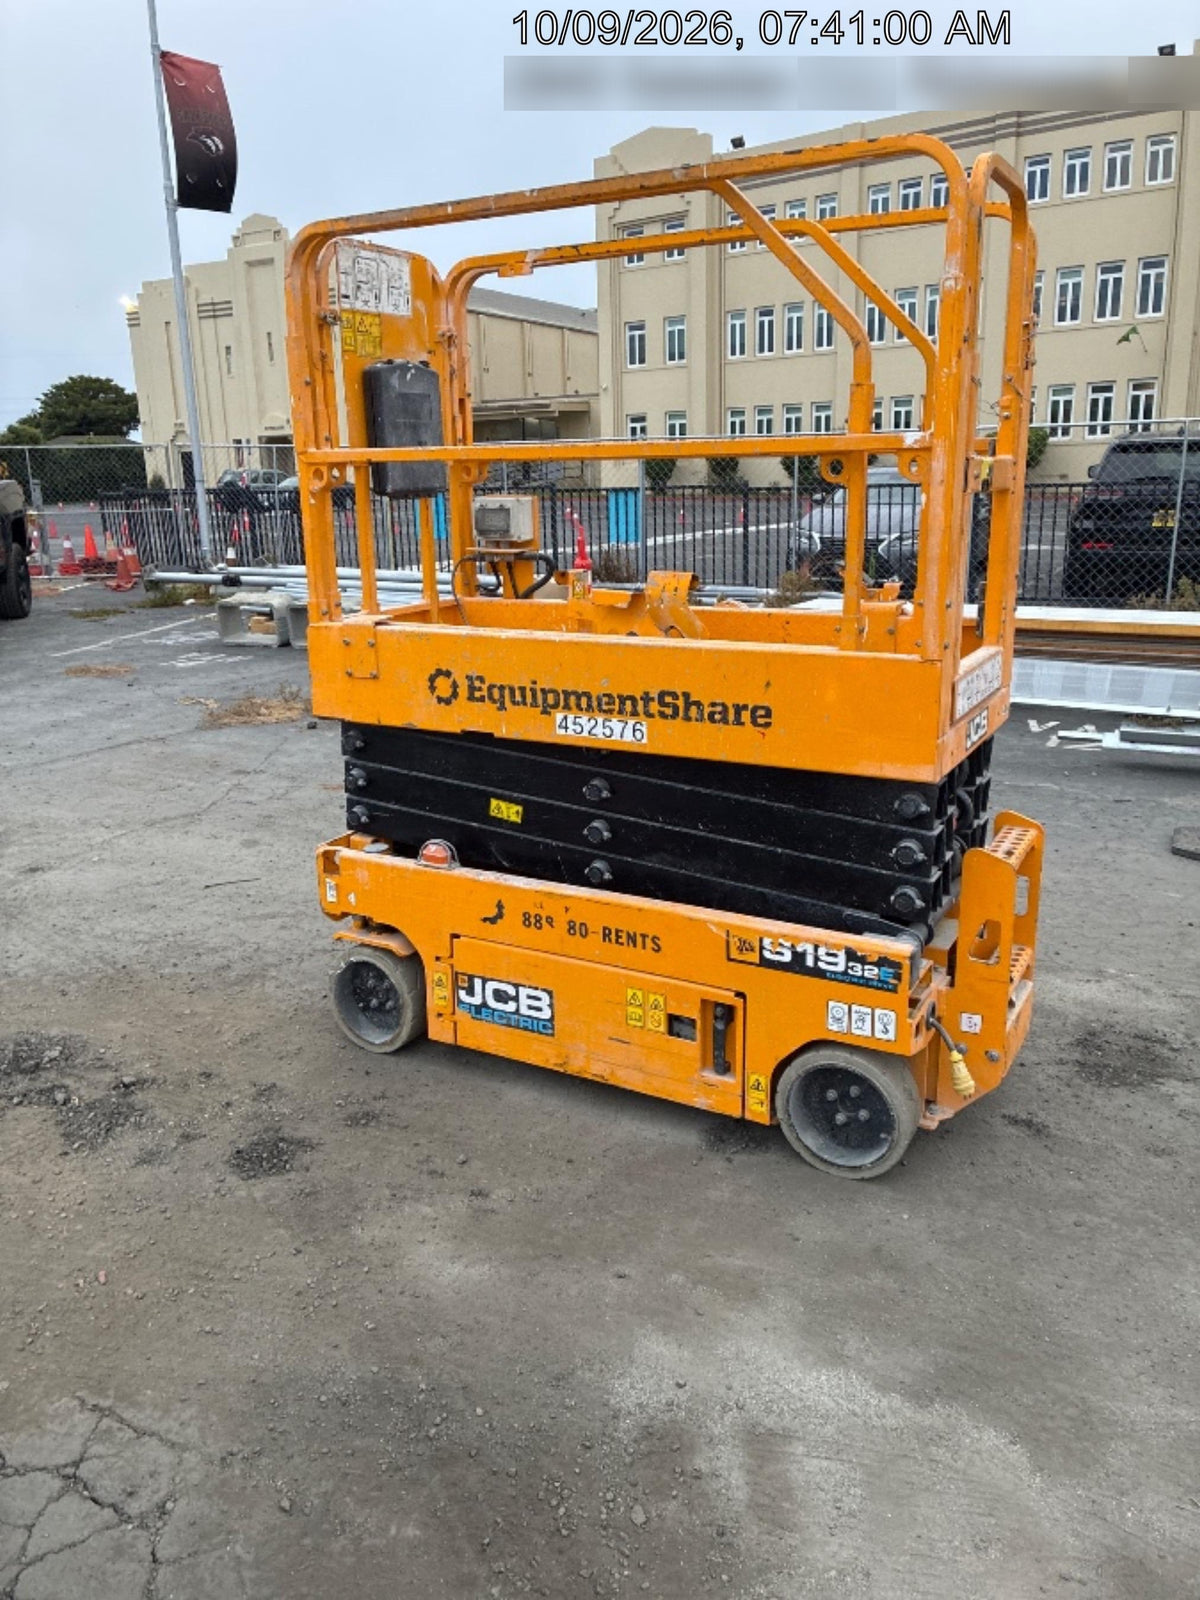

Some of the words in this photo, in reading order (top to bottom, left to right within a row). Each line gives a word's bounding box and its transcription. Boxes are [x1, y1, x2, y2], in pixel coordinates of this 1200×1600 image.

[466, 674, 773, 730] EquipmentShare
[557, 714, 646, 742] 452576
[458, 977, 552, 1020] JCB
[458, 1002, 554, 1035] ELECTRIC
